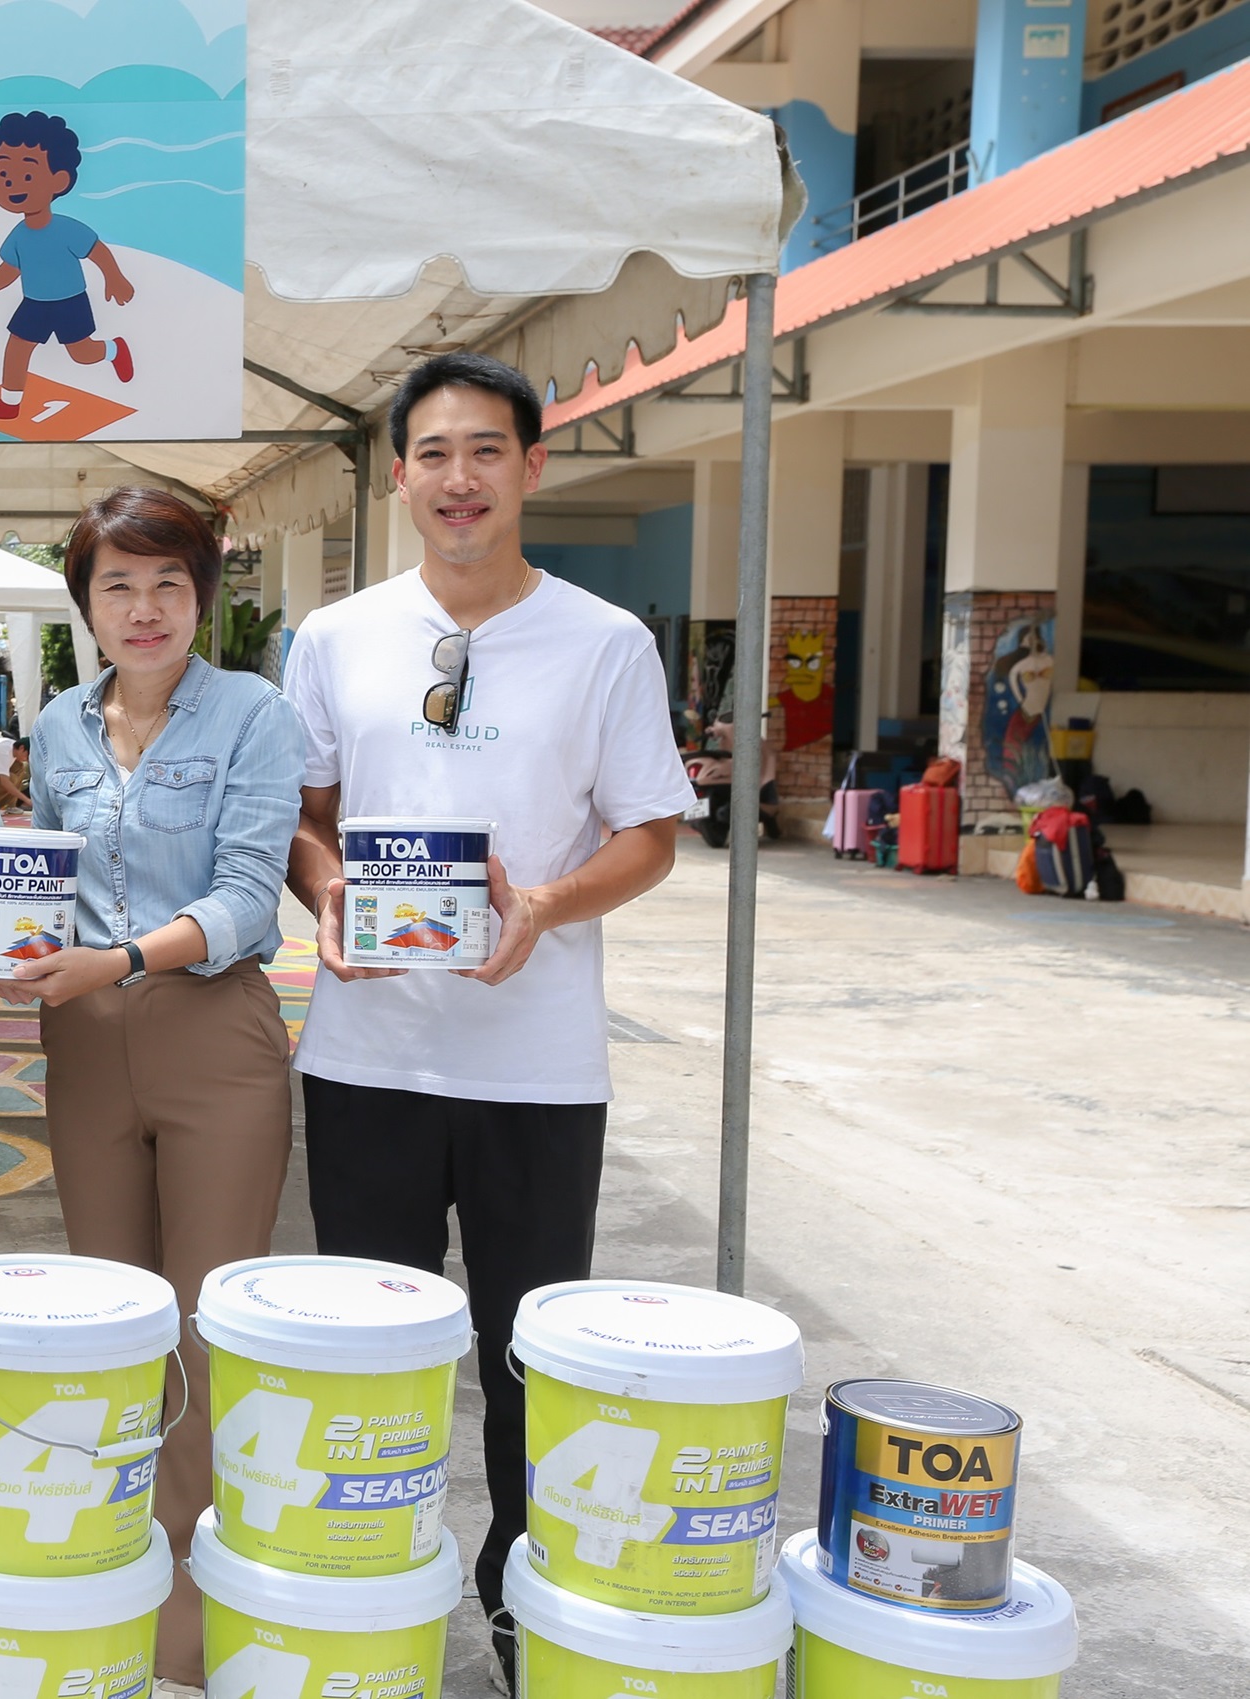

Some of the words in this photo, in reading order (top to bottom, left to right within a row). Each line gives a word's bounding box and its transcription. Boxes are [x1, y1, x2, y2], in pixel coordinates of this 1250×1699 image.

[31, 400, 71, 423] 1
[425, 741, 448, 749] REAL
[450, 743, 482, 752] ESTATE
[375, 837, 431, 860] TOA
[362, 863, 402, 877] ROOF
[407, 864, 453, 877] PAINT
[28, 879, 65, 893] PAINT
[53, 1383, 86, 1396] TOA
[257, 1372, 287, 1390] TOA
[117, 1403, 144, 1434] 2
[367, 1413, 413, 1428] PAINT
[414, 1410, 423, 1422] &
[597, 1403, 631, 1422] TOA
[323, 1414, 363, 1442] 2
[380, 1424, 431, 1443] PRIMER
[327, 1444, 356, 1460] IN
[355, 1433, 376, 1460] 1
[716, 1444, 758, 1460] PAINT
[759, 1441, 768, 1452] &
[212, 1388, 328, 1533] 4
[671, 1446, 713, 1474] 2
[728, 1455, 774, 1475] PRIMER
[888, 1435, 993, 1483] TOA
[125, 1454, 157, 1493] SEA
[703, 1464, 725, 1493] 1
[534, 1419, 678, 1569] 4
[674, 1476, 704, 1493] IN
[869, 1482, 1003, 1518] ExtraWET
[686, 1500, 776, 1538] SEASO
[913, 1514, 967, 1530] PRIMER
[875, 1520, 906, 1534] Excellent
[908, 1529, 941, 1540] Adhesion
[942, 1533, 977, 1541] Breathable
[305, 1561, 319, 1569] FOR
[320, 1562, 351, 1571] INTERIOR
[612, 1582, 641, 1593] SEASONS
[702, 1590, 730, 1598] EMULSION
[731, 1587, 744, 1595] PAINT
[665, 1599, 697, 1607] INTERIOR
[1005, 1600, 1034, 1620] Living
[253, 1627, 284, 1646] TOA
[98, 1656, 136, 1678] PAINT
[135, 1651, 143, 1663] &
[364, 1667, 407, 1684] PAINT
[408, 1663, 419, 1676] &
[108, 1664, 149, 1691] PRIMER
[376, 1676, 427, 1699] PRIMER
[621, 1676, 658, 1693] TOA
[911, 1680, 947, 1697] TOA
